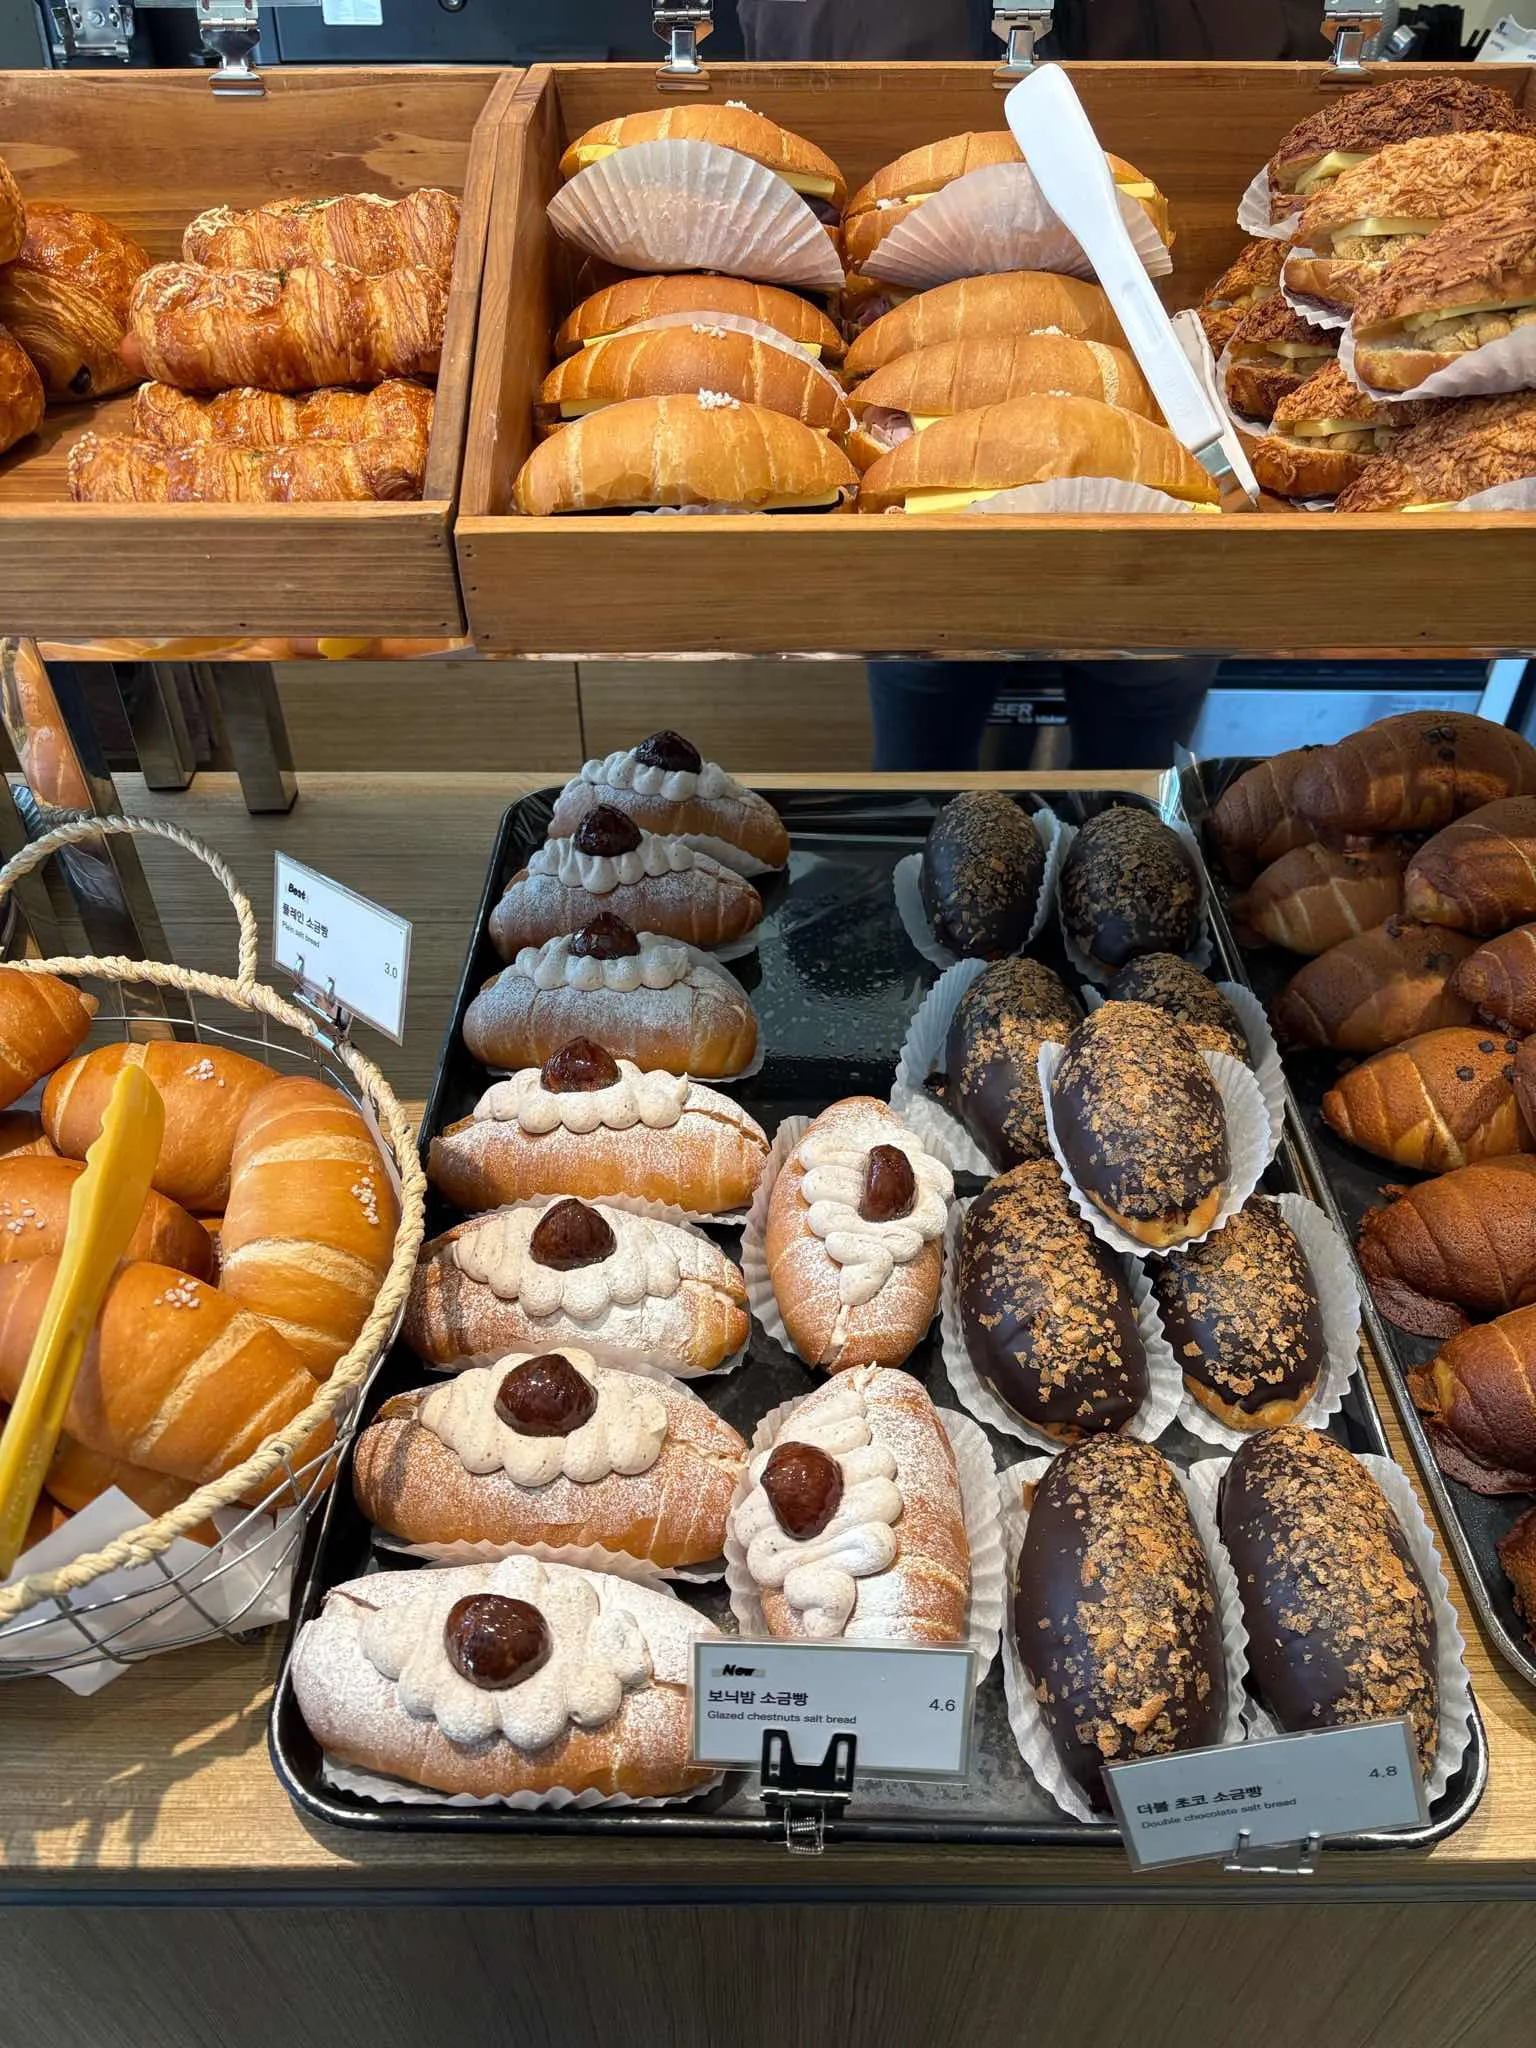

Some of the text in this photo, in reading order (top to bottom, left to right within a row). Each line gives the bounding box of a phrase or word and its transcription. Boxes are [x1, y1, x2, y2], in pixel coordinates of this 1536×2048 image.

[288, 883, 306, 900] Best
[282, 902, 329, 938] 플레인 소금빵
[384, 962, 398, 979] 3.0
[722, 1663, 756, 1676] New
[707, 1689, 809, 1706] 보늬밤 소금빵
[929, 1698, 956, 1712] 4.6
[707, 1710, 857, 1724] Glazed chestnuts salt bread
[1367, 1765, 1398, 1780] 4.8
[1136, 1784, 1264, 1815] 더블 초코 소금빵
[1142, 1798, 1297, 1829] Double chocolate salt bread
